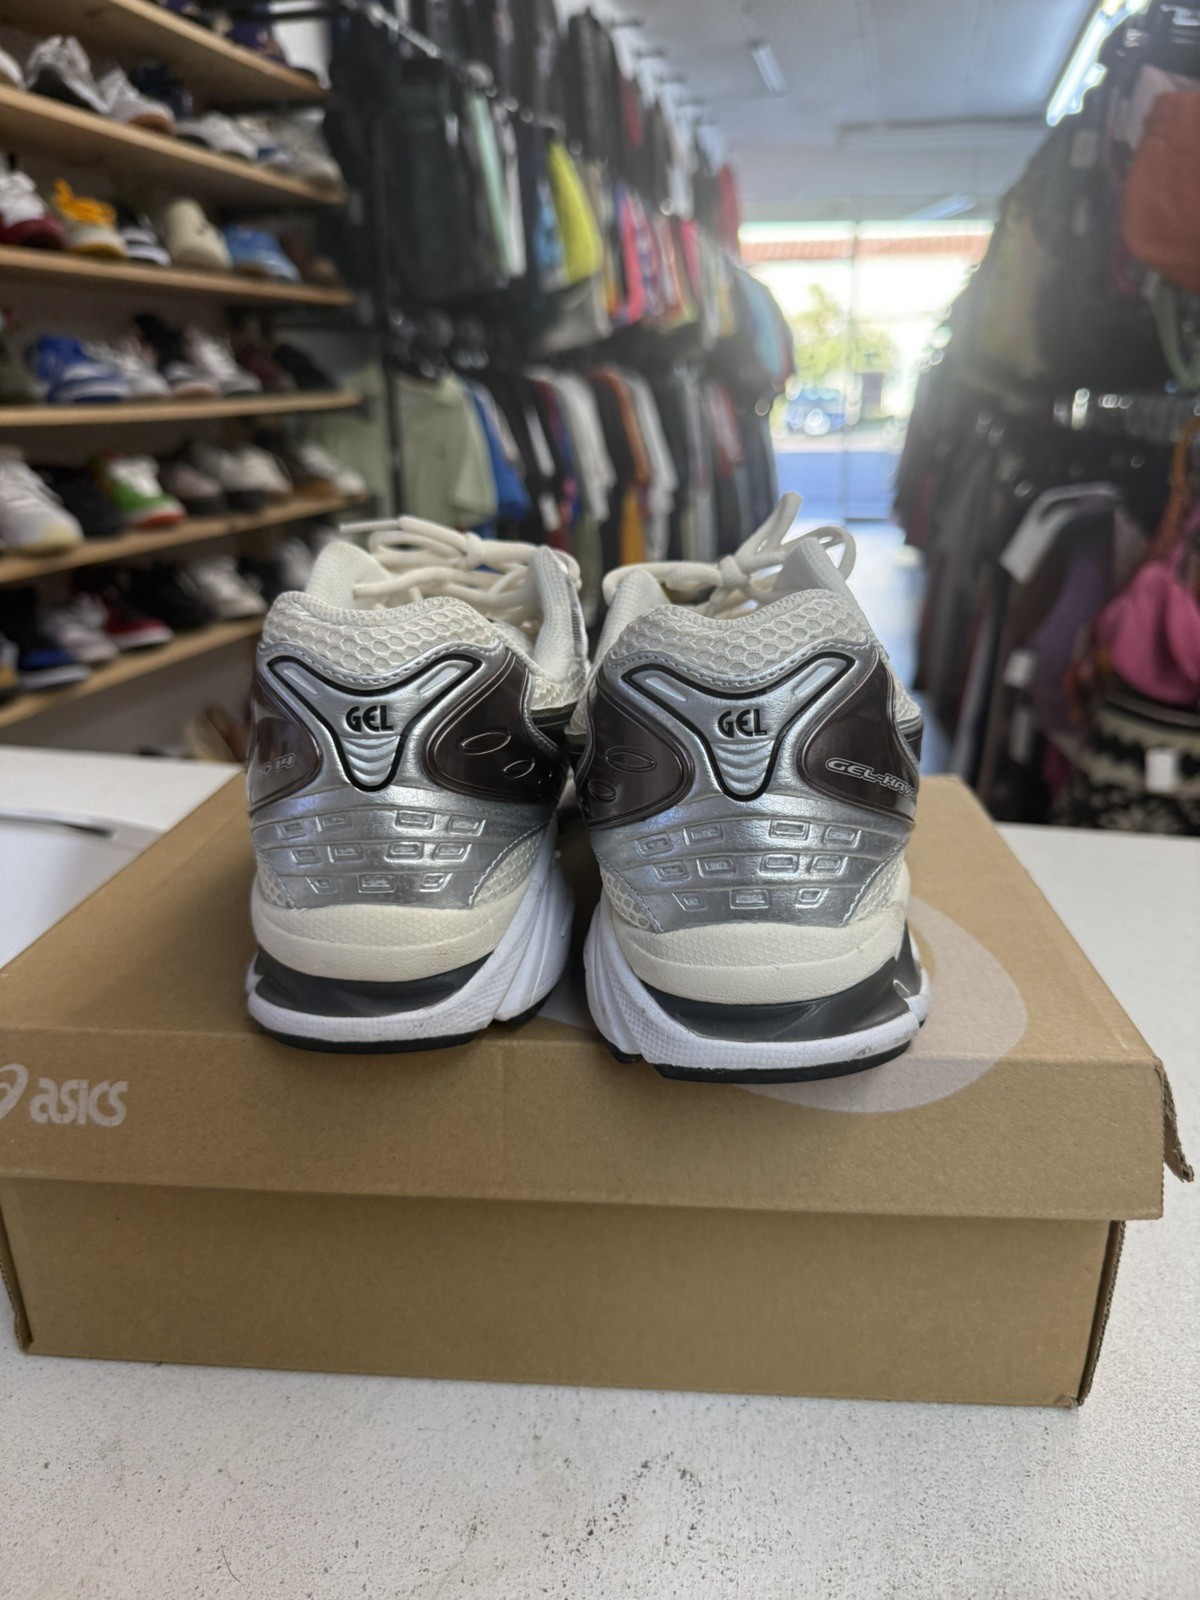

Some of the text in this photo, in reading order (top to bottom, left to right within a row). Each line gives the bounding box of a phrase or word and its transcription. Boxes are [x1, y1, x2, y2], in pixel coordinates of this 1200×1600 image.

[345, 704, 394, 733] GEL
[717, 708, 767, 738] GEL
[30, 1077, 128, 1127] asics
